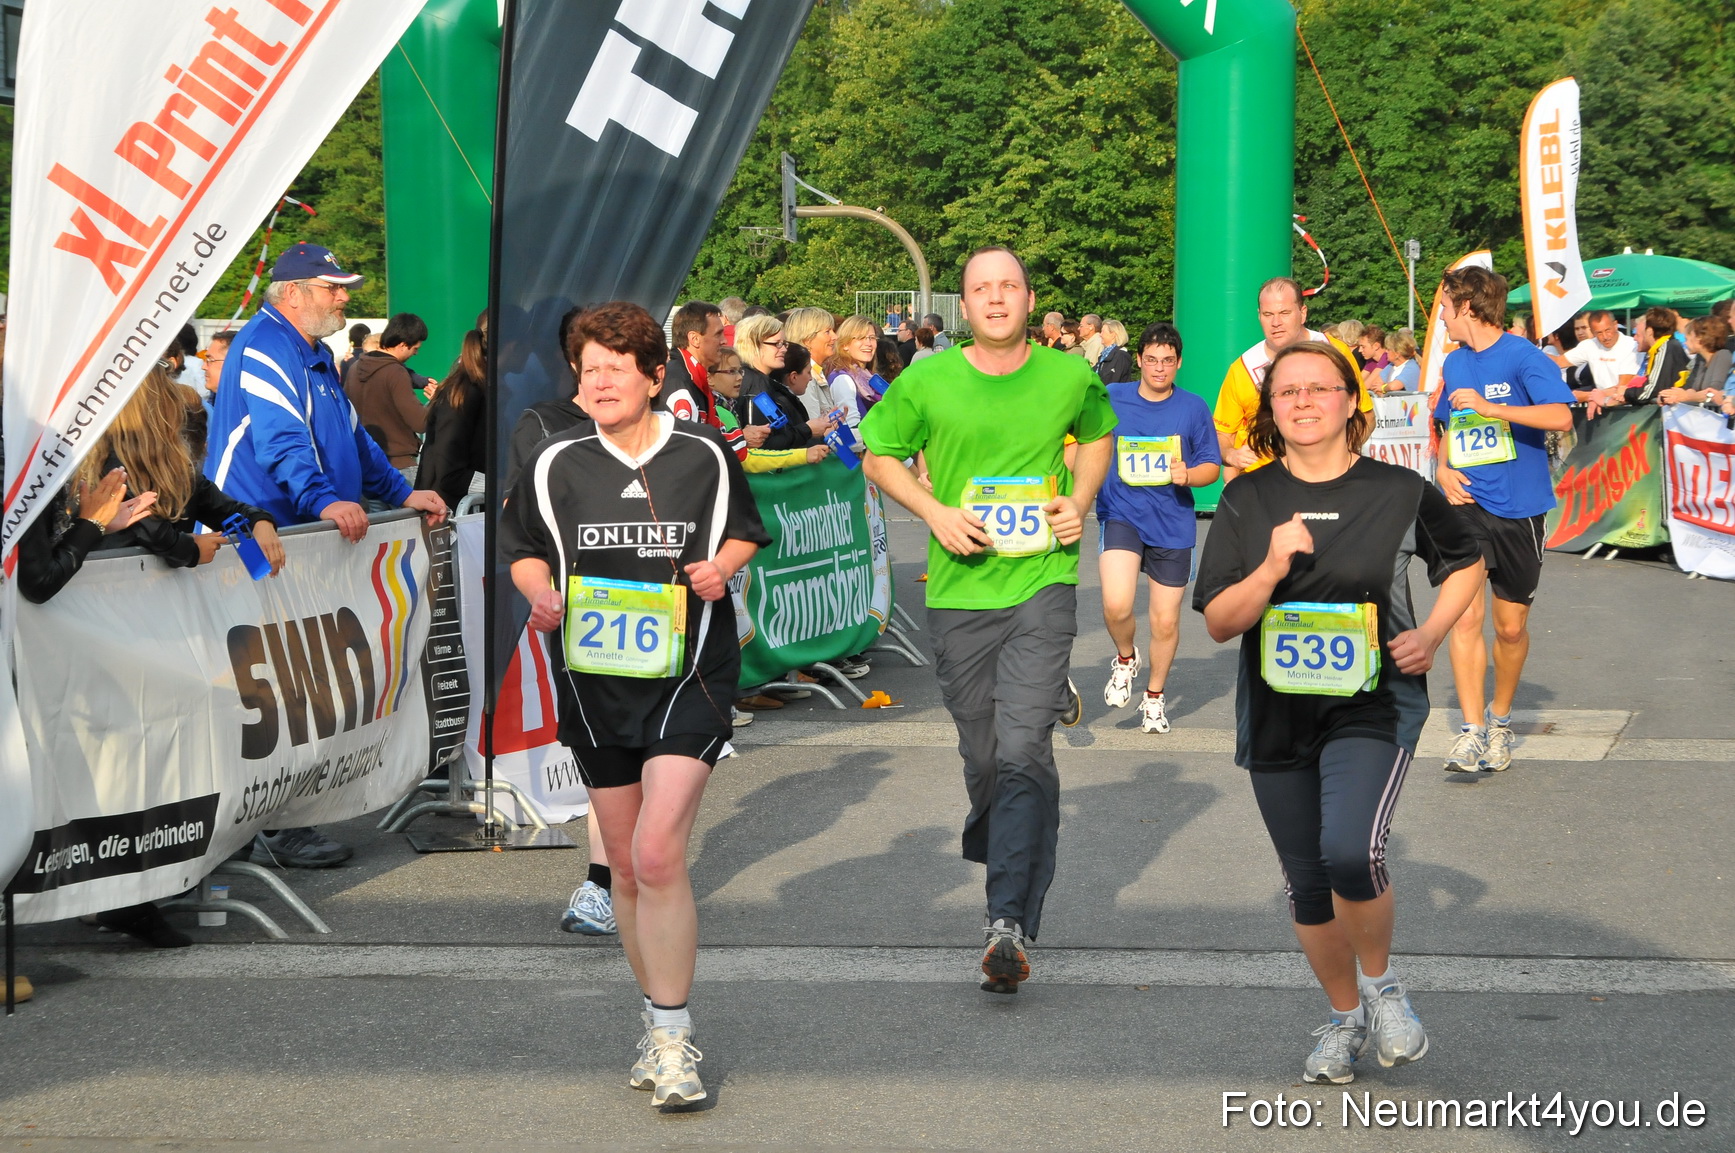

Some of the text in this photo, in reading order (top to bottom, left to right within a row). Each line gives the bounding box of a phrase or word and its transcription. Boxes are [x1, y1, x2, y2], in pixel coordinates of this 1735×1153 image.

[114, 6, 289, 200] Print
[1539, 108, 1567, 251] KLEBL
[1455, 426, 1498, 452] 128
[1126, 453, 1168, 473] 114
[773, 489, 854, 559] Neumarkter
[972, 505, 1040, 536] 795
[637, 547, 683, 559] Germany
[757, 549, 871, 649] Lammsbräu
[578, 611, 659, 653] 216
[586, 649, 624, 661] Annette
[1275, 634, 1355, 671] 539
[1287, 671, 1322, 680] Monika
[434, 716, 466, 730] Stadtbusse
[98, 834, 130, 859] die
[135, 820, 203, 854] verbinden
